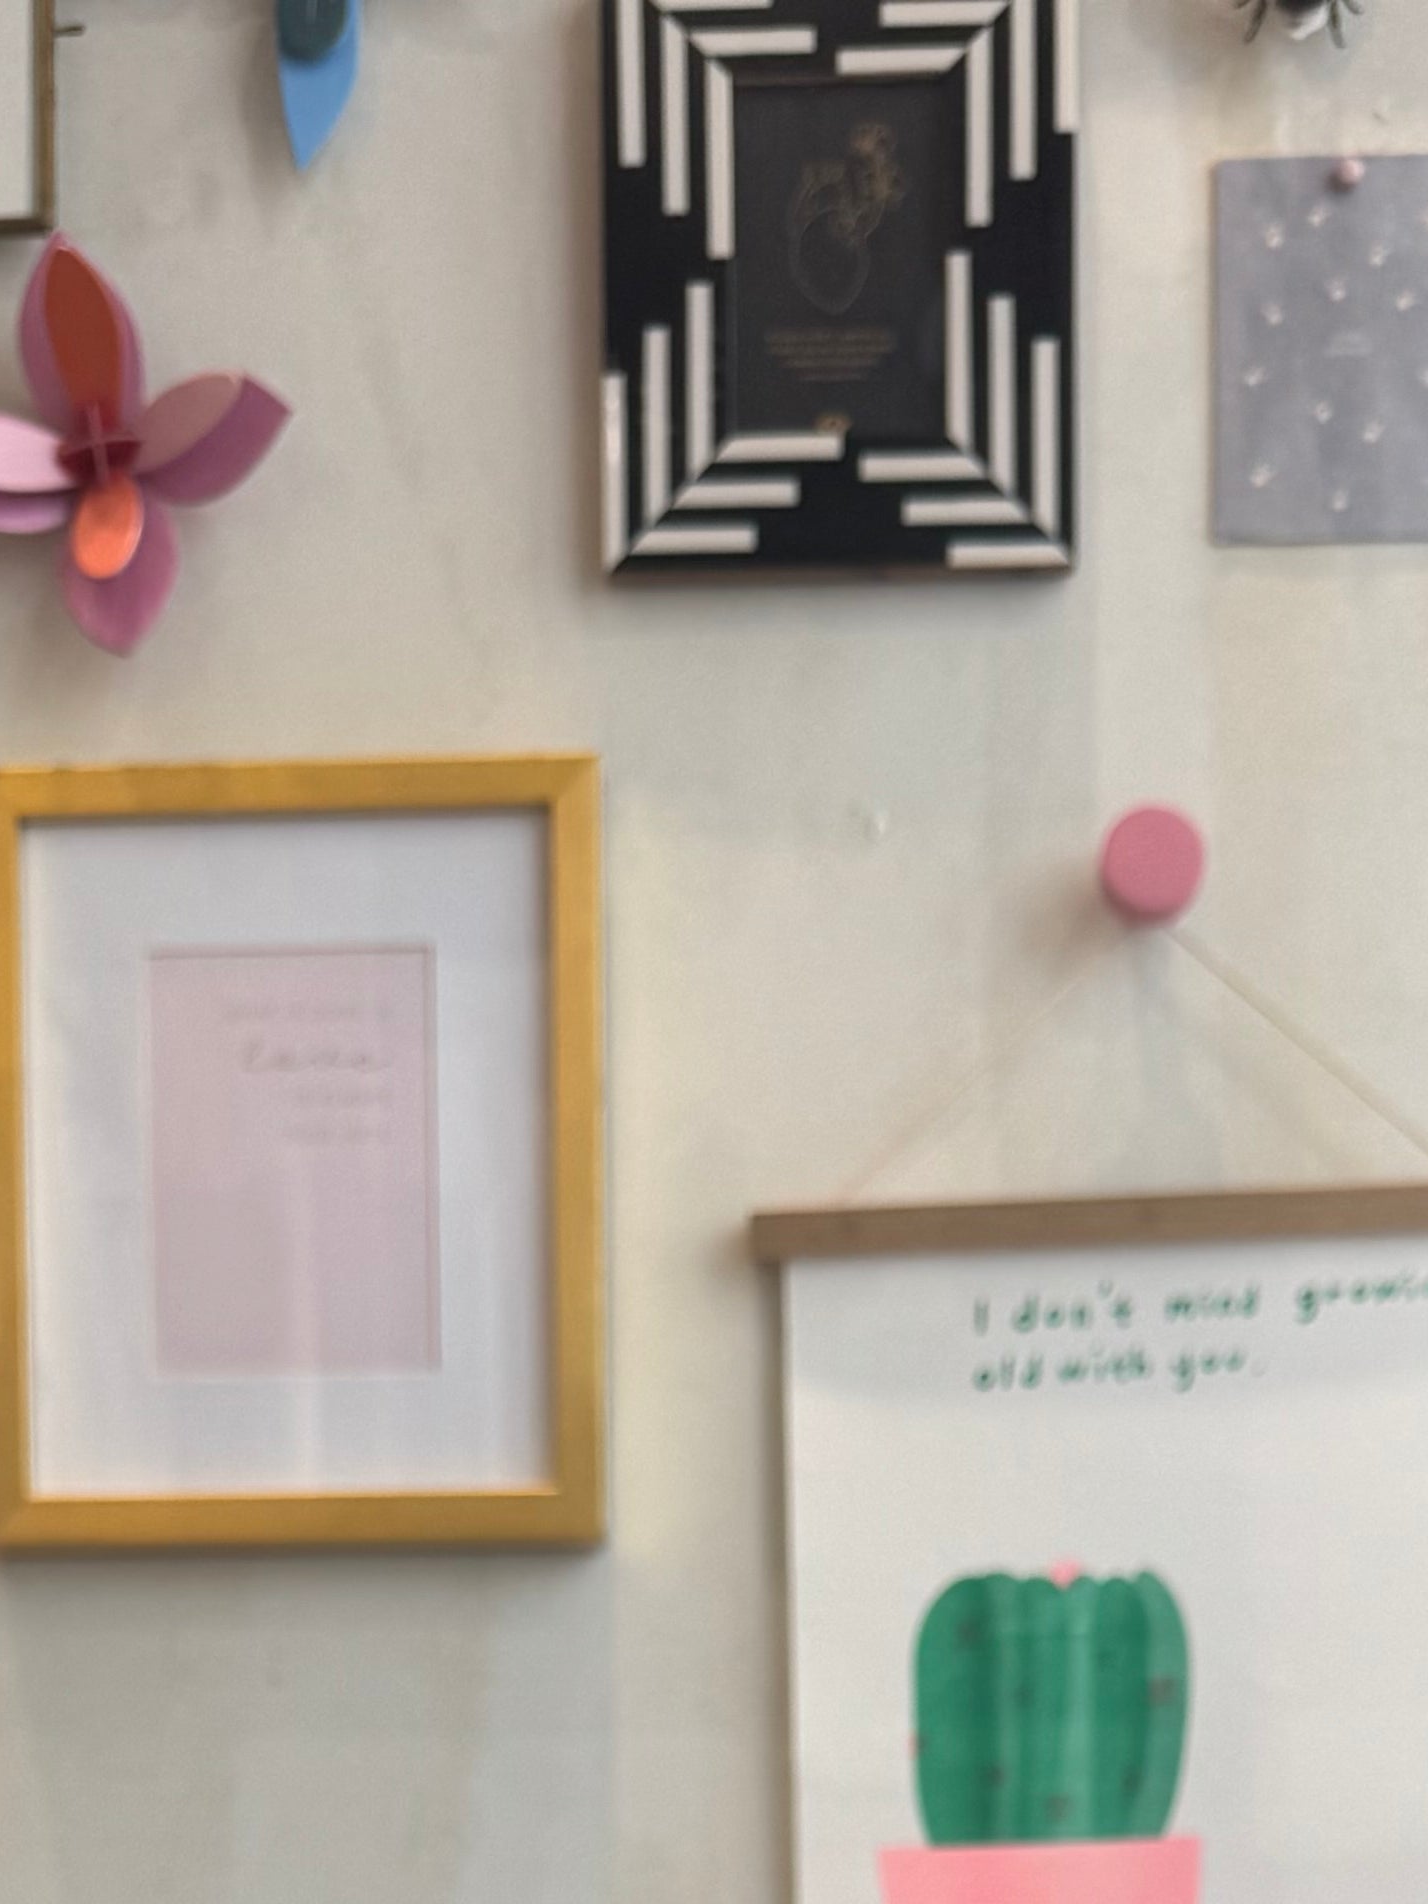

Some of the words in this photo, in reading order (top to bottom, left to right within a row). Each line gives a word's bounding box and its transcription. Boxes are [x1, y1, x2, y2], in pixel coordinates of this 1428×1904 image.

[973, 1297, 990, 1337] I
[1011, 1280, 1134, 1334] don't
[1165, 1283, 1260, 1320] mind
[973, 1355, 1044, 1391] old
[1057, 1346, 1154, 1383] with
